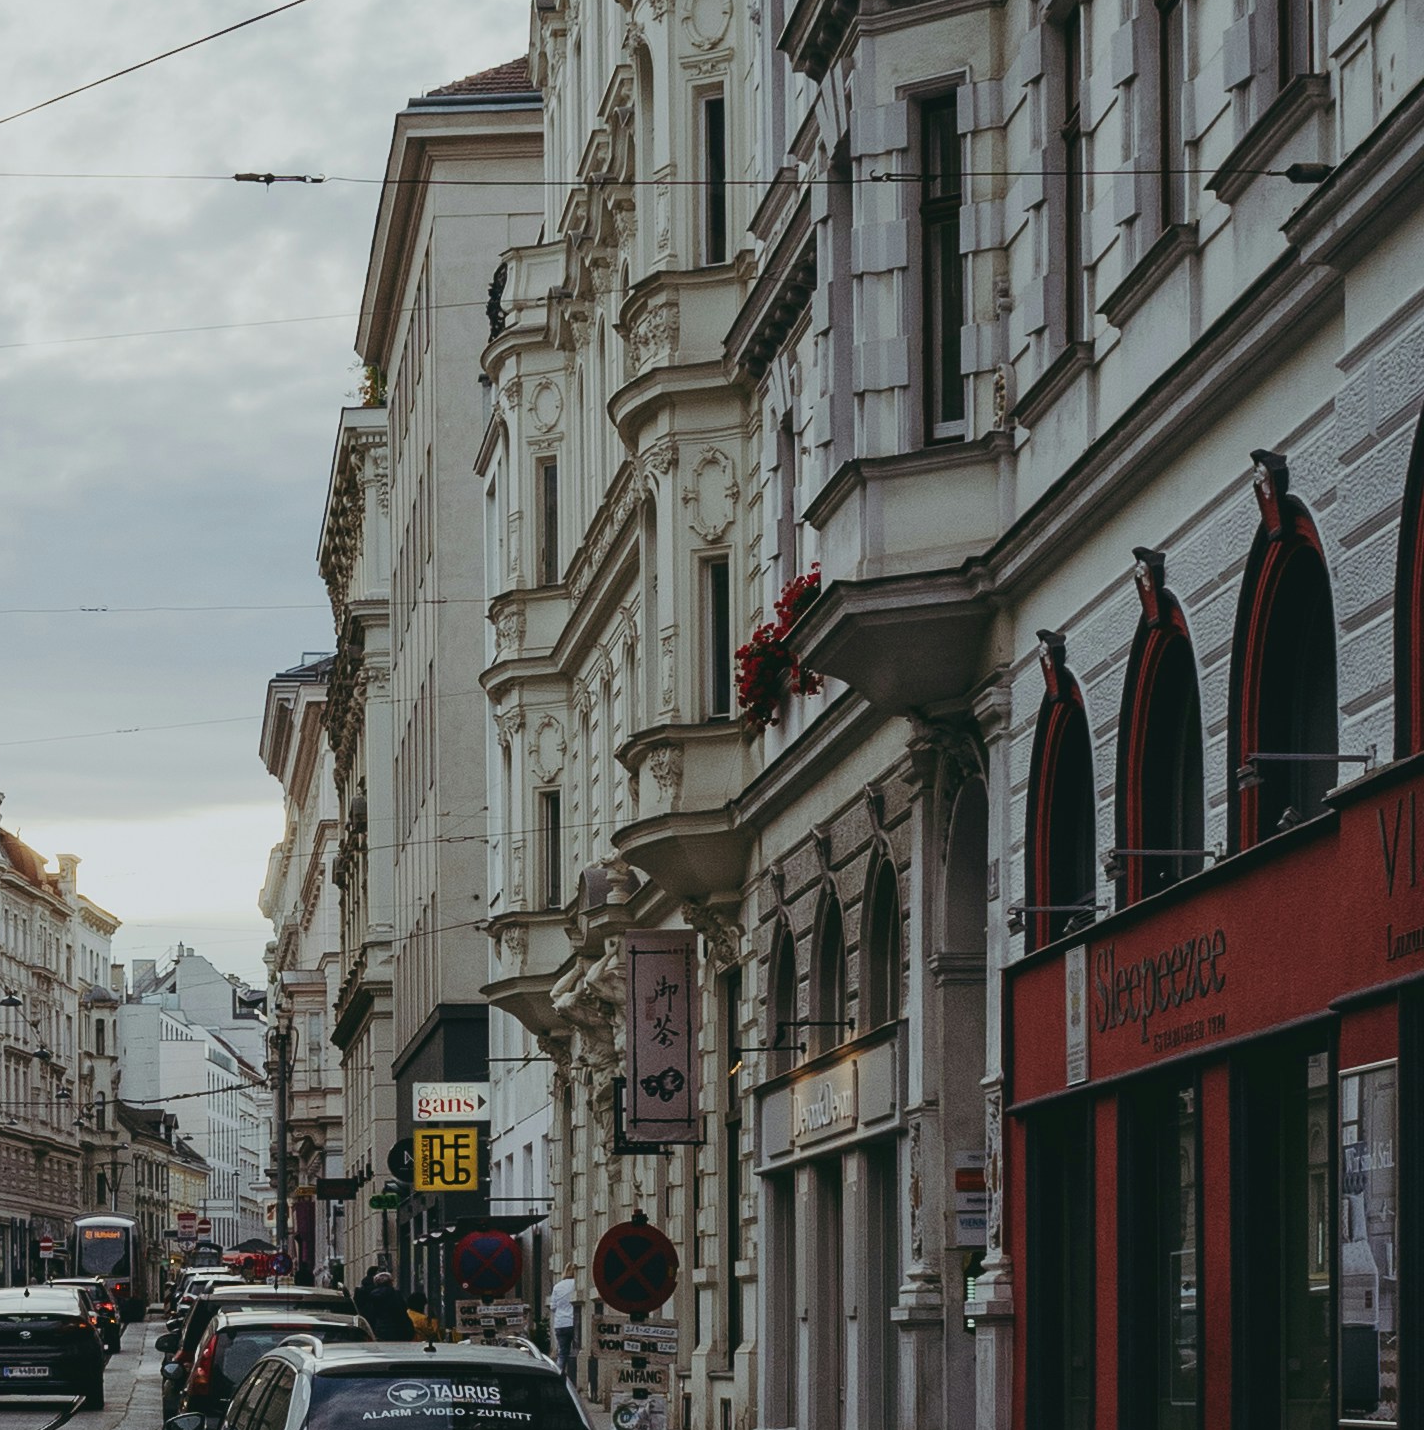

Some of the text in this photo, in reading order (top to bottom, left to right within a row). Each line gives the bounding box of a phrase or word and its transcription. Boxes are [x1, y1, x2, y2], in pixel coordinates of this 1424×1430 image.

[1094, 927, 1226, 1044] Sleepeezee
[1154, 1019, 1205, 1053] ESTABLISHED
[417, 1085, 475, 1098] GALERIE
[417, 1098, 475, 1119] gans
[421, 1134, 471, 1160] THE
[421, 1139, 430, 1186] BUKOWSKI
[597, 1324, 621, 1335] GILT
[598, 1339, 624, 1350] VON
[641, 1341, 657, 1352] BIS
[618, 1369, 663, 1384] ANFANG
[430, 1384, 501, 1400] TAURUS
[362, 1408, 412, 1421] ALARM
[423, 1407, 466, 1416] VIDEO
[476, 1409, 533, 1422] ZUTRITT
